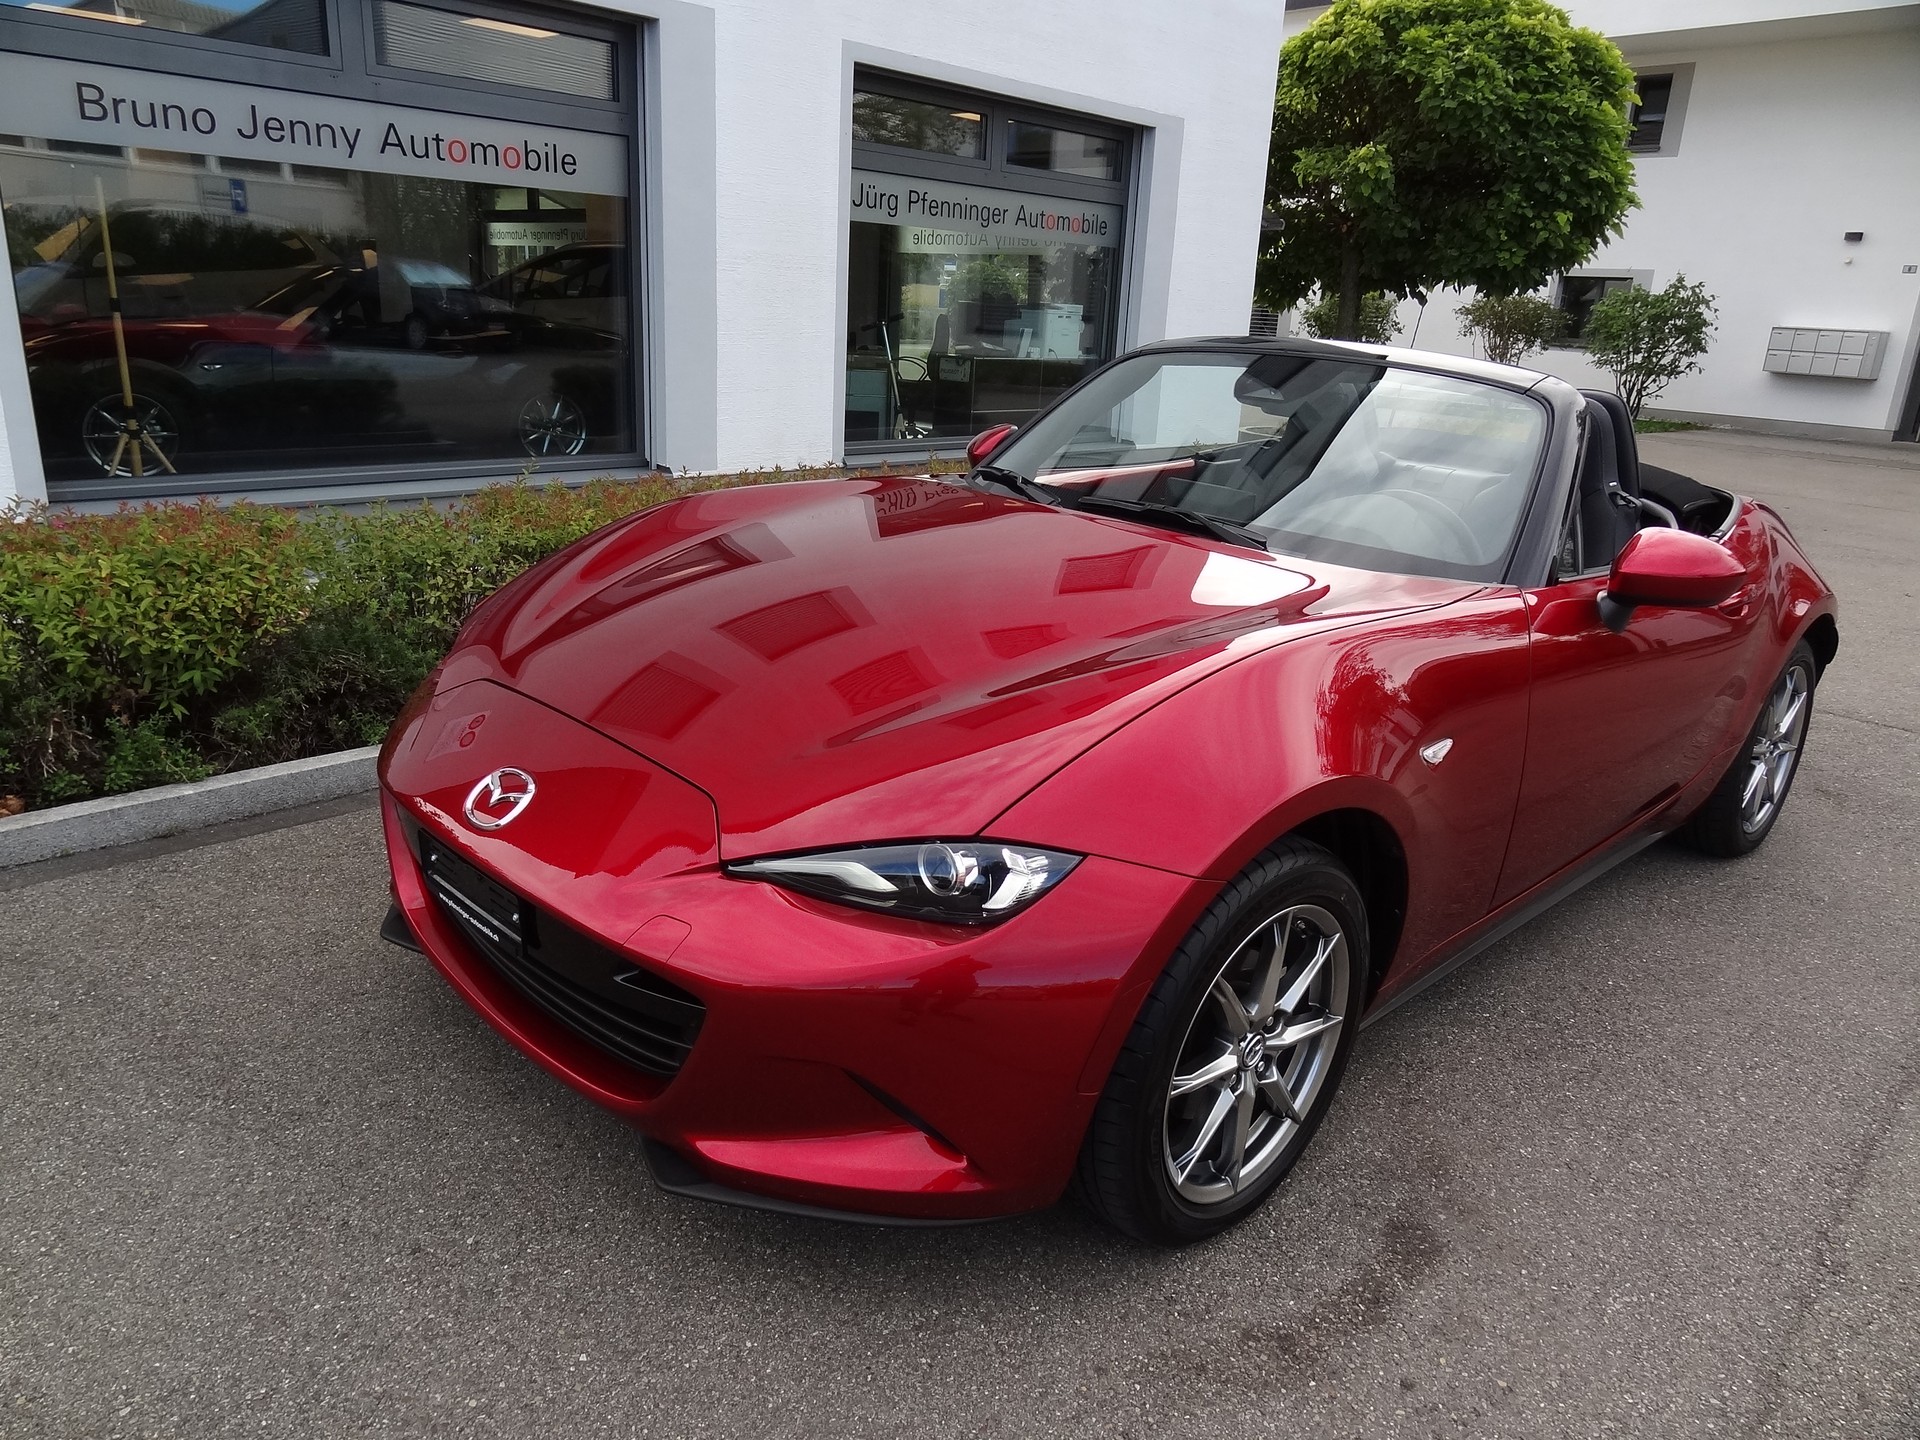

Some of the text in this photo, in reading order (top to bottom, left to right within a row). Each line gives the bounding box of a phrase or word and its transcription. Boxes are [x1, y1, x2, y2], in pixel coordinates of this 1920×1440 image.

[76, 82, 578, 176] Bruno Jenny Automobile
[852, 182, 1109, 237] Jürg Pfenninger Automobile
